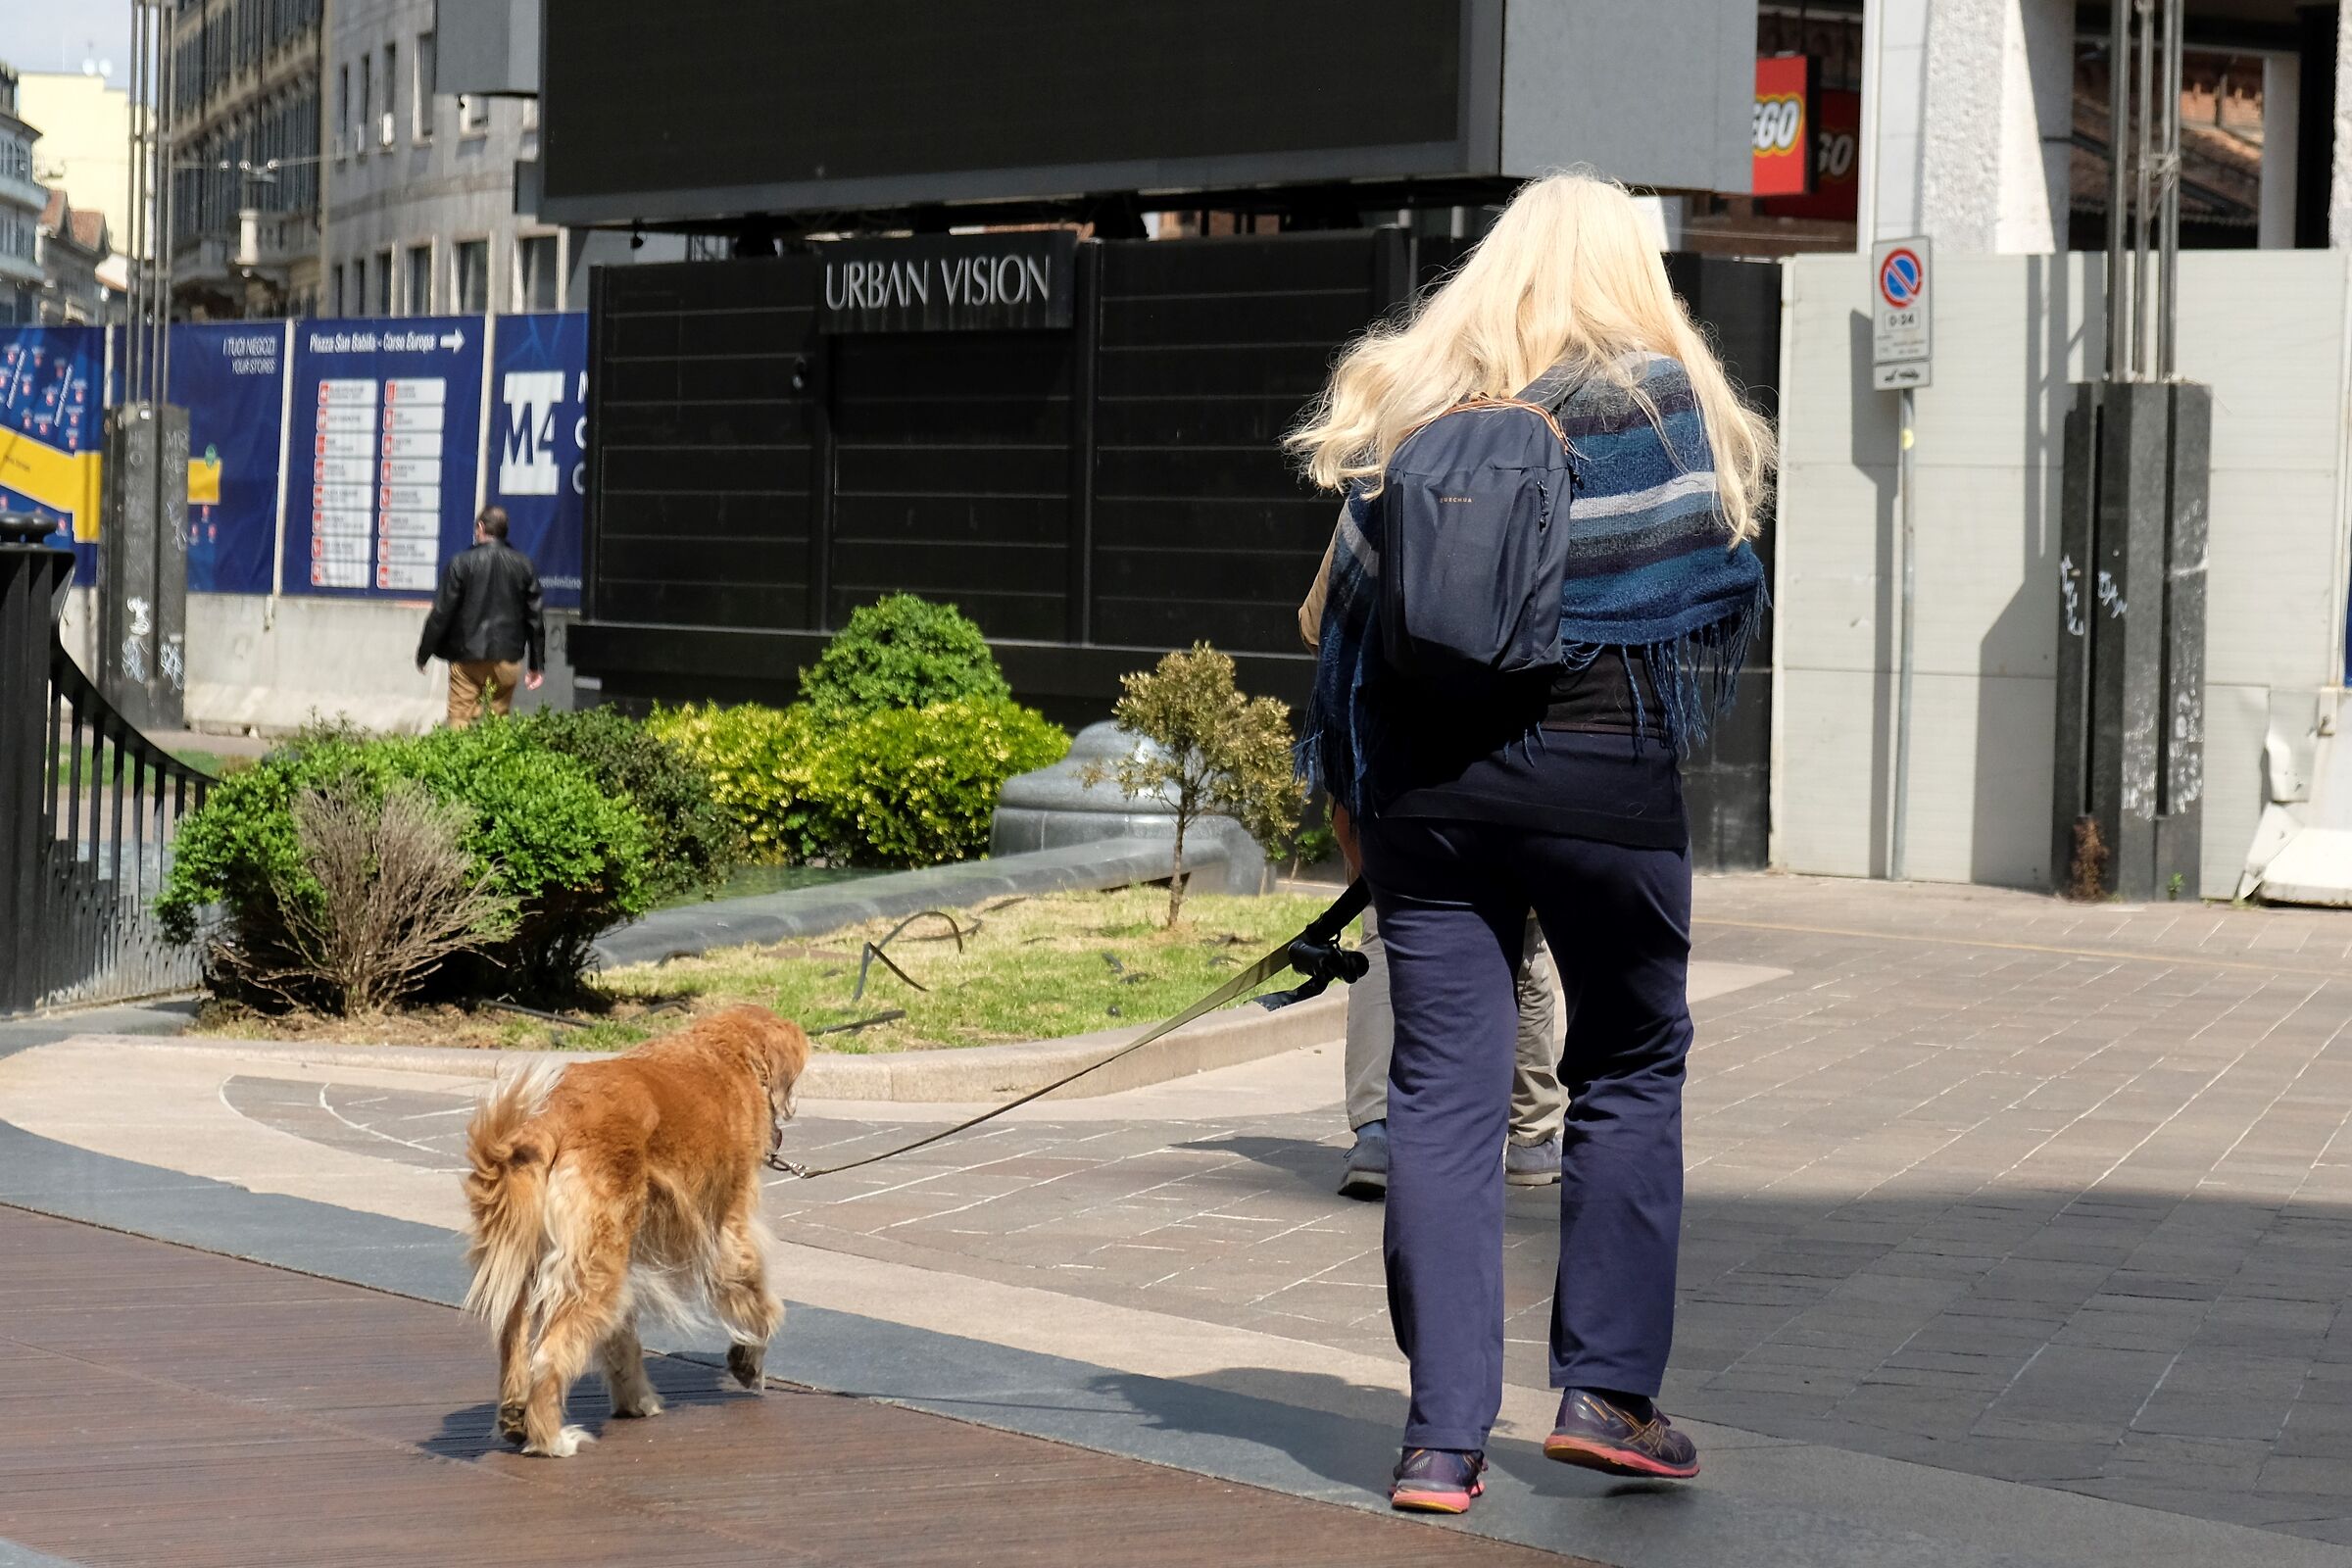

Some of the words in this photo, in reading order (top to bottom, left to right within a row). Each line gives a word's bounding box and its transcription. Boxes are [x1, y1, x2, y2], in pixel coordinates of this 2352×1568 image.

[1752, 100, 1800, 150] EGO
[826, 259, 930, 311] URBAN
[941, 254, 1051, 306] VISION
[246, 336, 276, 357] NEGOZI
[310, 333, 334, 354] Piazza
[335, 332, 351, 353] San
[351, 332, 376, 353] Babila
[383, 331, 406, 353] Corso
[406, 330, 436, 354] Europa
